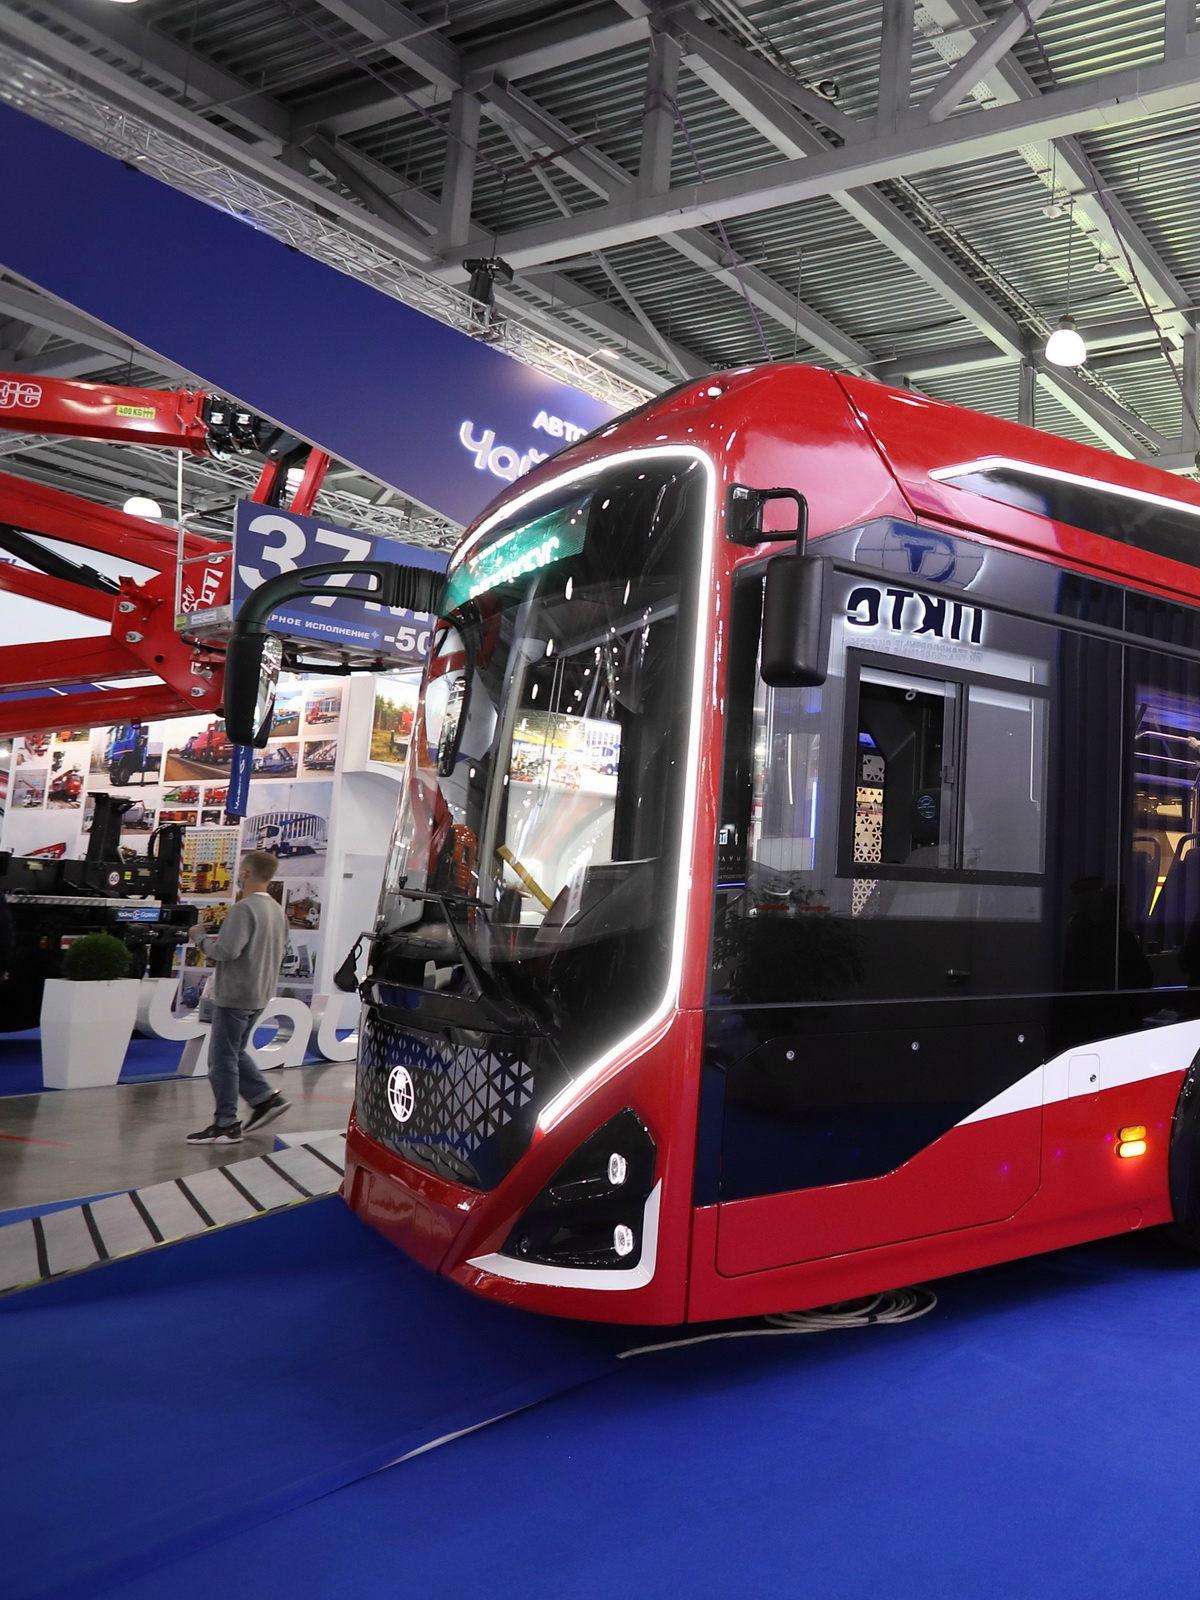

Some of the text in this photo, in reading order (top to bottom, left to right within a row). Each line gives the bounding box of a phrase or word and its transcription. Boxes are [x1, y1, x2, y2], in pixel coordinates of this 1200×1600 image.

[118, 406, 142, 416] 400 KG
[268, 614, 301, 626] РНОЕ
[305, 620, 370, 639] ИСПОЛНЕНИЕ
[110, 874, 119, 883] 60
